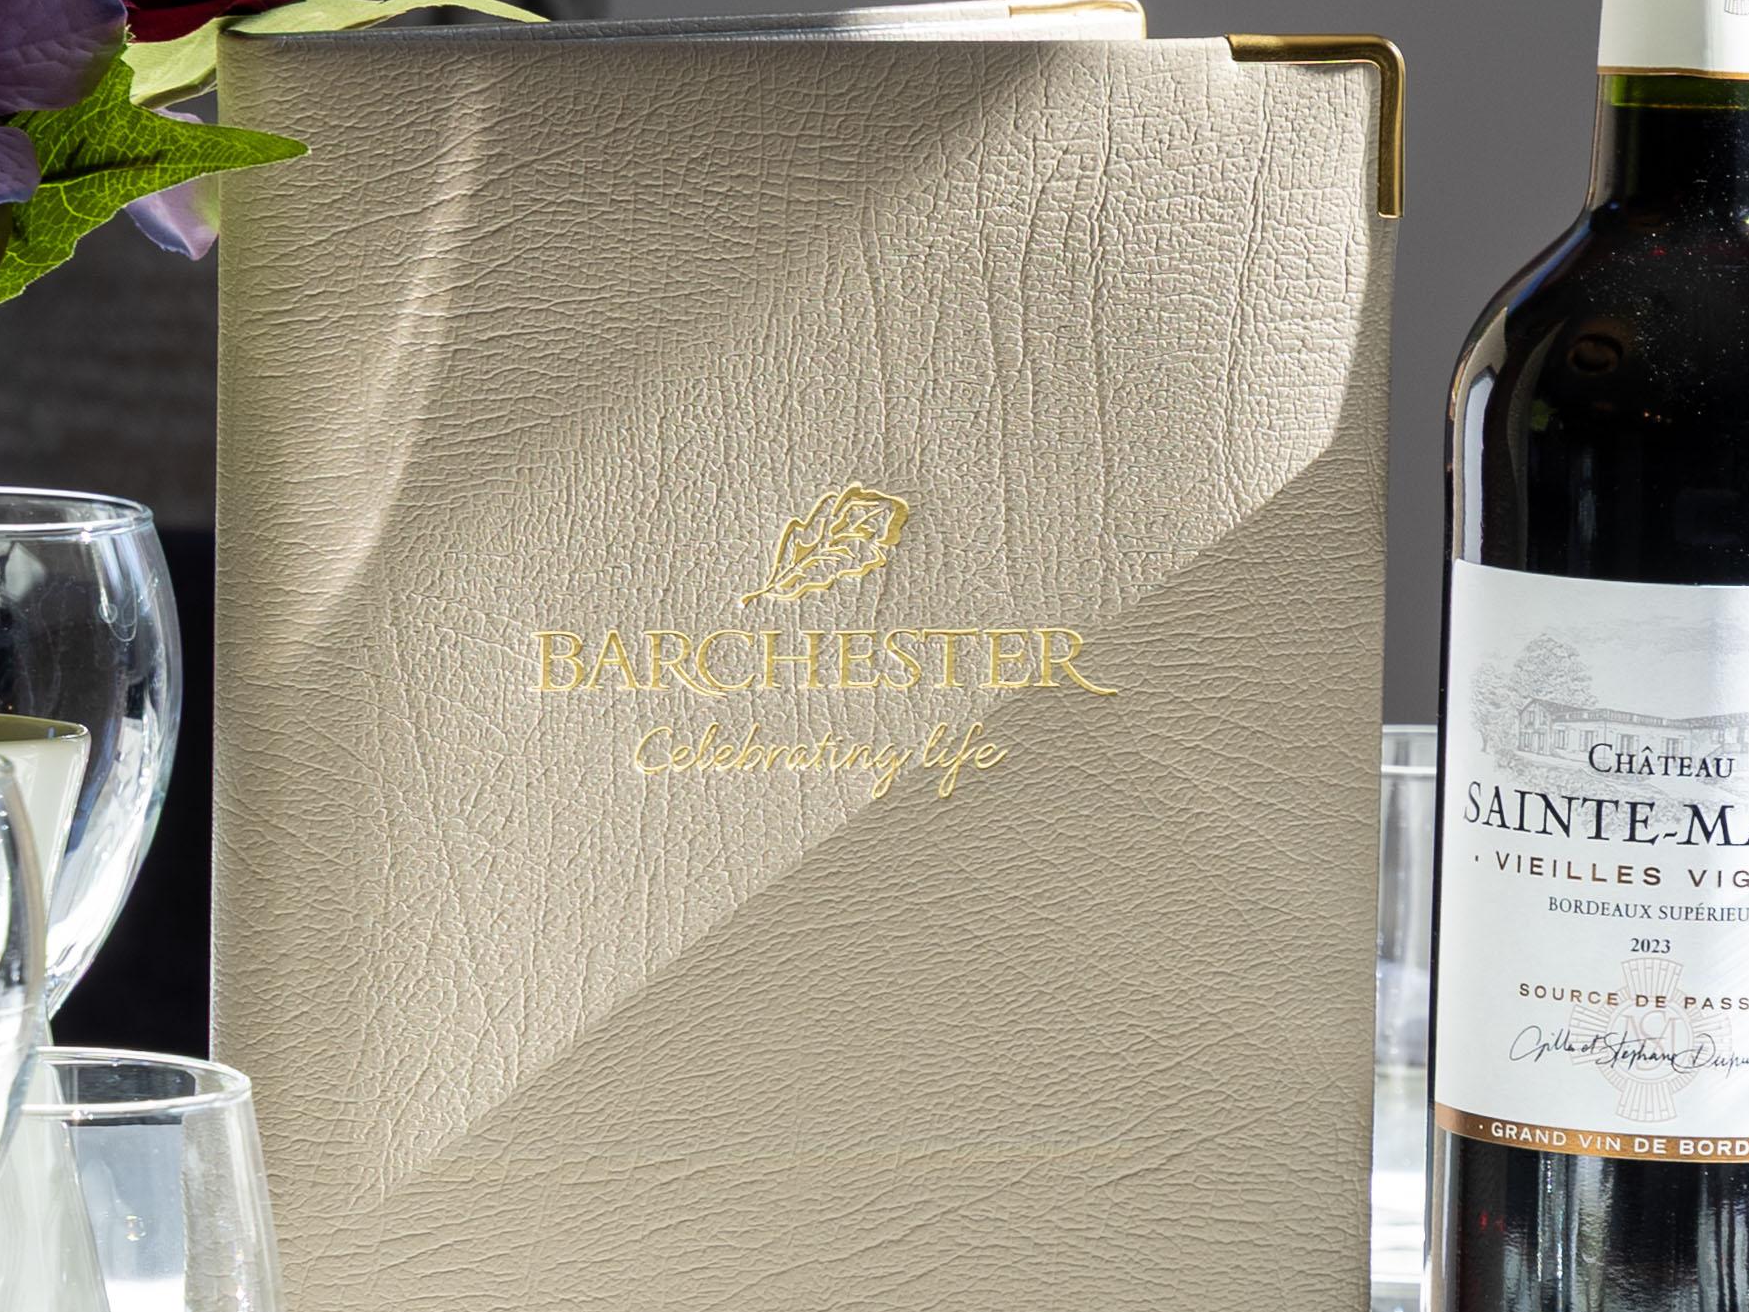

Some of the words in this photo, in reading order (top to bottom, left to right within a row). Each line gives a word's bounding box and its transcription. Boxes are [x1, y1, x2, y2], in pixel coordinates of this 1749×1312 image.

[531, 628, 1118, 697] BARCHESTER
[636, 723, 914, 798] Celebrating
[922, 721, 1009, 798] life
[1588, 742, 1736, 778] CHÂTEAU
[1495, 851, 1663, 886] VIEILLES
[1548, 897, 1653, 920] BORDEAUX
[1630, 938, 1672, 955] 2023
[1519, 983, 1619, 1006] SOURCE
[1636, 994, 1667, 1009] DE
[1491, 1121, 1567, 1147] GRAND
[1579, 1134, 1622, 1151] VIN
[1633, 1137, 1667, 1154] DE
